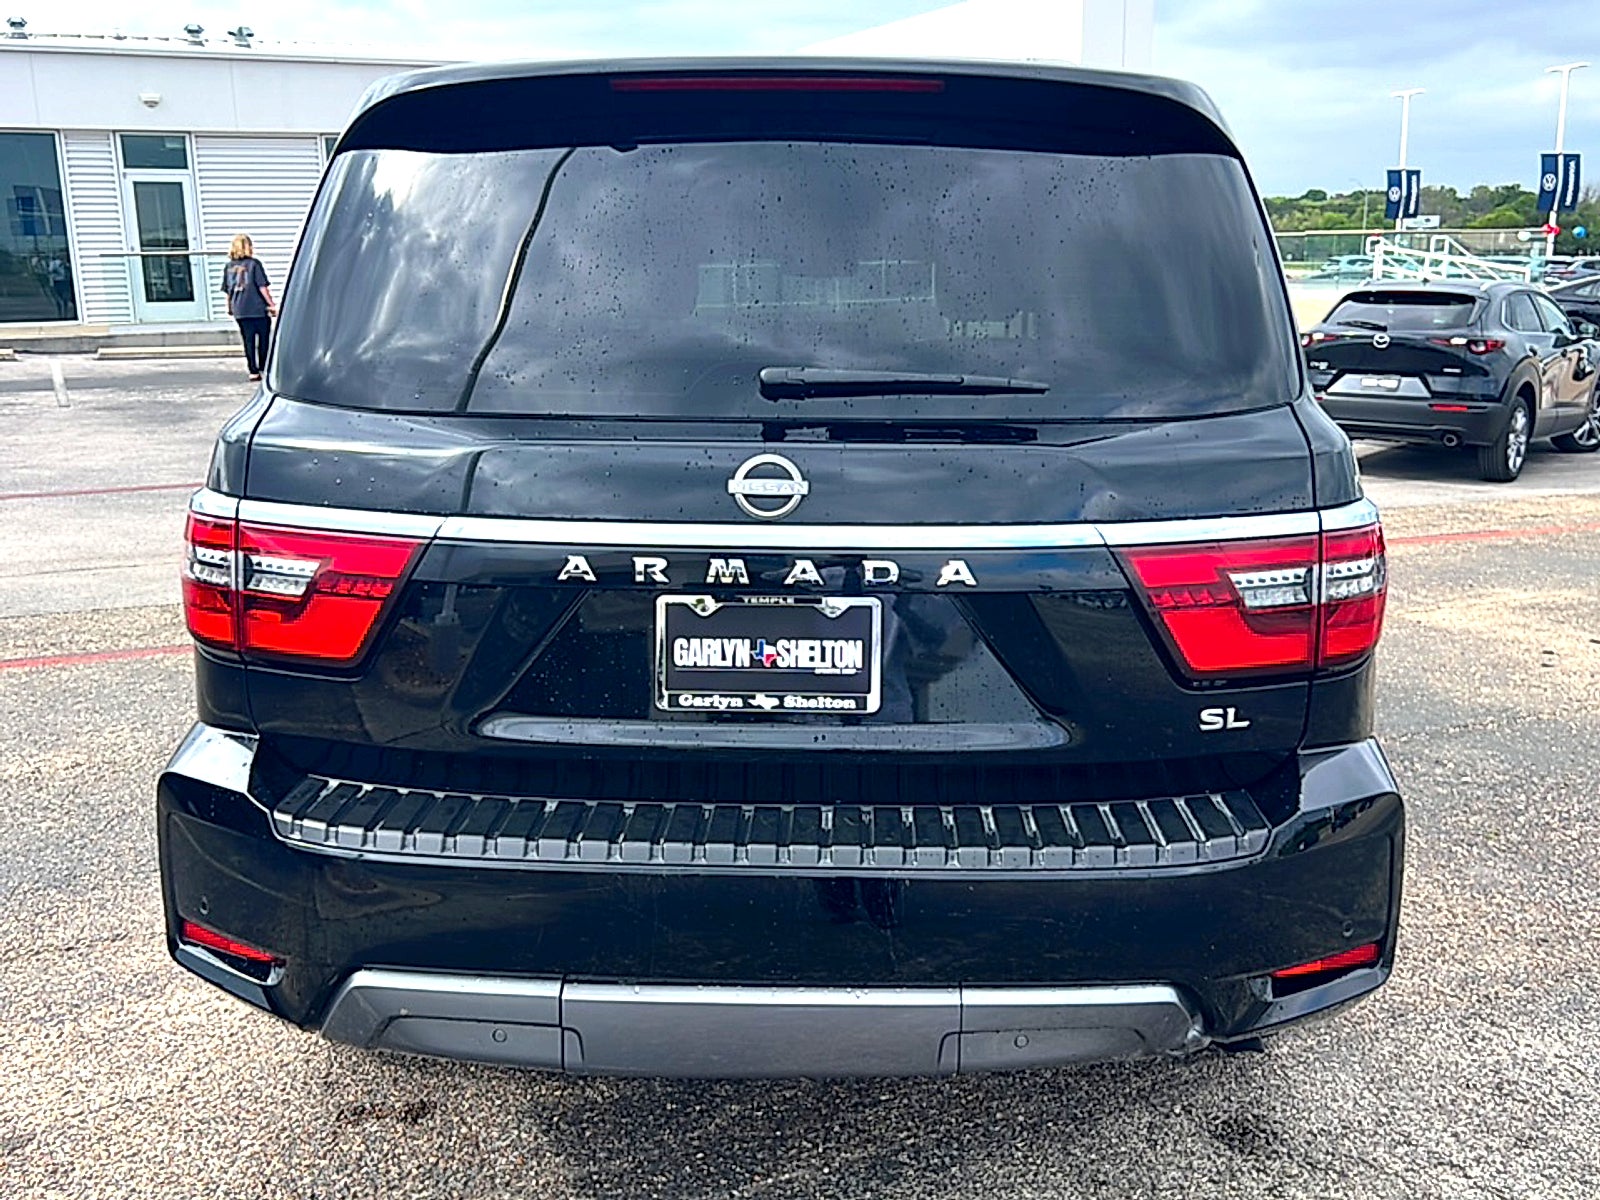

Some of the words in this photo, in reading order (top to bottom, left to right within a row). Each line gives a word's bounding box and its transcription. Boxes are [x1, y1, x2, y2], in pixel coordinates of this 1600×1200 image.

[734, 481, 805, 493] NISSAN
[557, 555, 979, 586] ARMADA
[742, 596, 795, 605] TEMPLE
[673, 638, 751, 668] GARLYN
[776, 639, 863, 669] SHELTON
[678, 693, 744, 710] Garlyn
[783, 694, 857, 710] Shelton
[1199, 707, 1250, 731] SL
